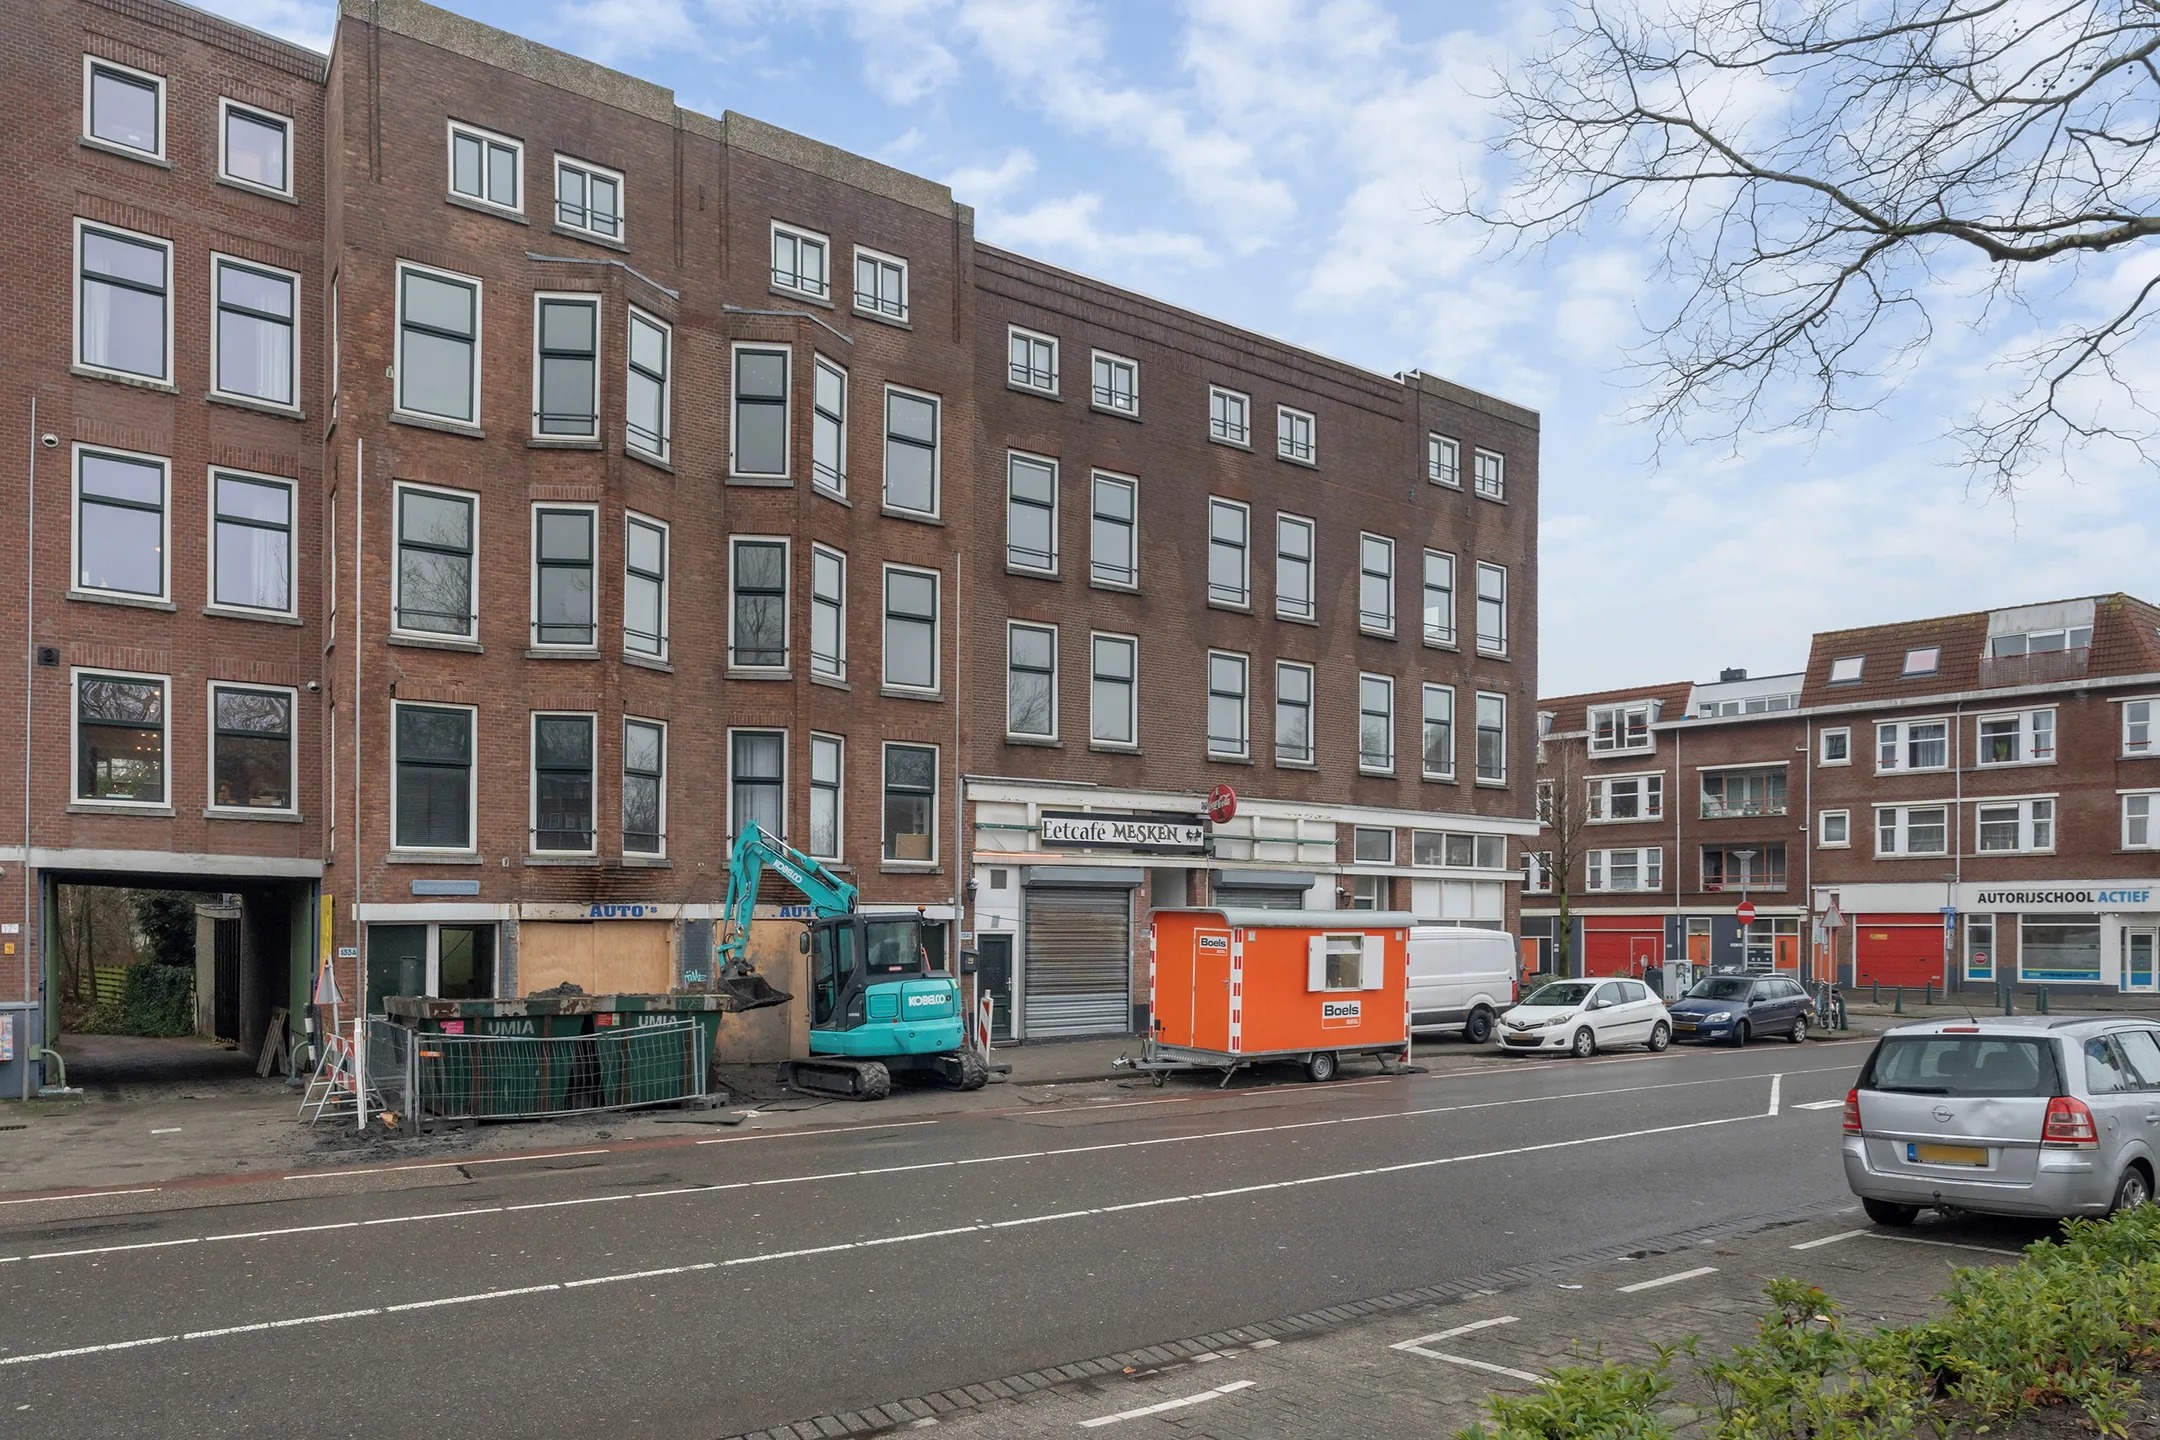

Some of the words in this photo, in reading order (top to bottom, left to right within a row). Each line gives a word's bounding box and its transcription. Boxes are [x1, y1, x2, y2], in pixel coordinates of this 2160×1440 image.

[1043, 820, 1106, 841] Eetcafé
[1111, 822, 1181, 843] MESKEN
[773, 859, 803, 883] KOBELCO
[1977, 891, 2095, 904] AUTORIJSCHOOL
[2097, 890, 2150, 903] ACTIEF
[590, 905, 657, 917] AUTO's
[780, 906, 812, 917] AUT
[1200, 938, 1226, 948] Boels
[908, 994, 946, 1007] KOBELCO
[1324, 1004, 1359, 1016] Boels
[638, 1014, 679, 1028] UMIA
[487, 1020, 535, 1036] UMIA
